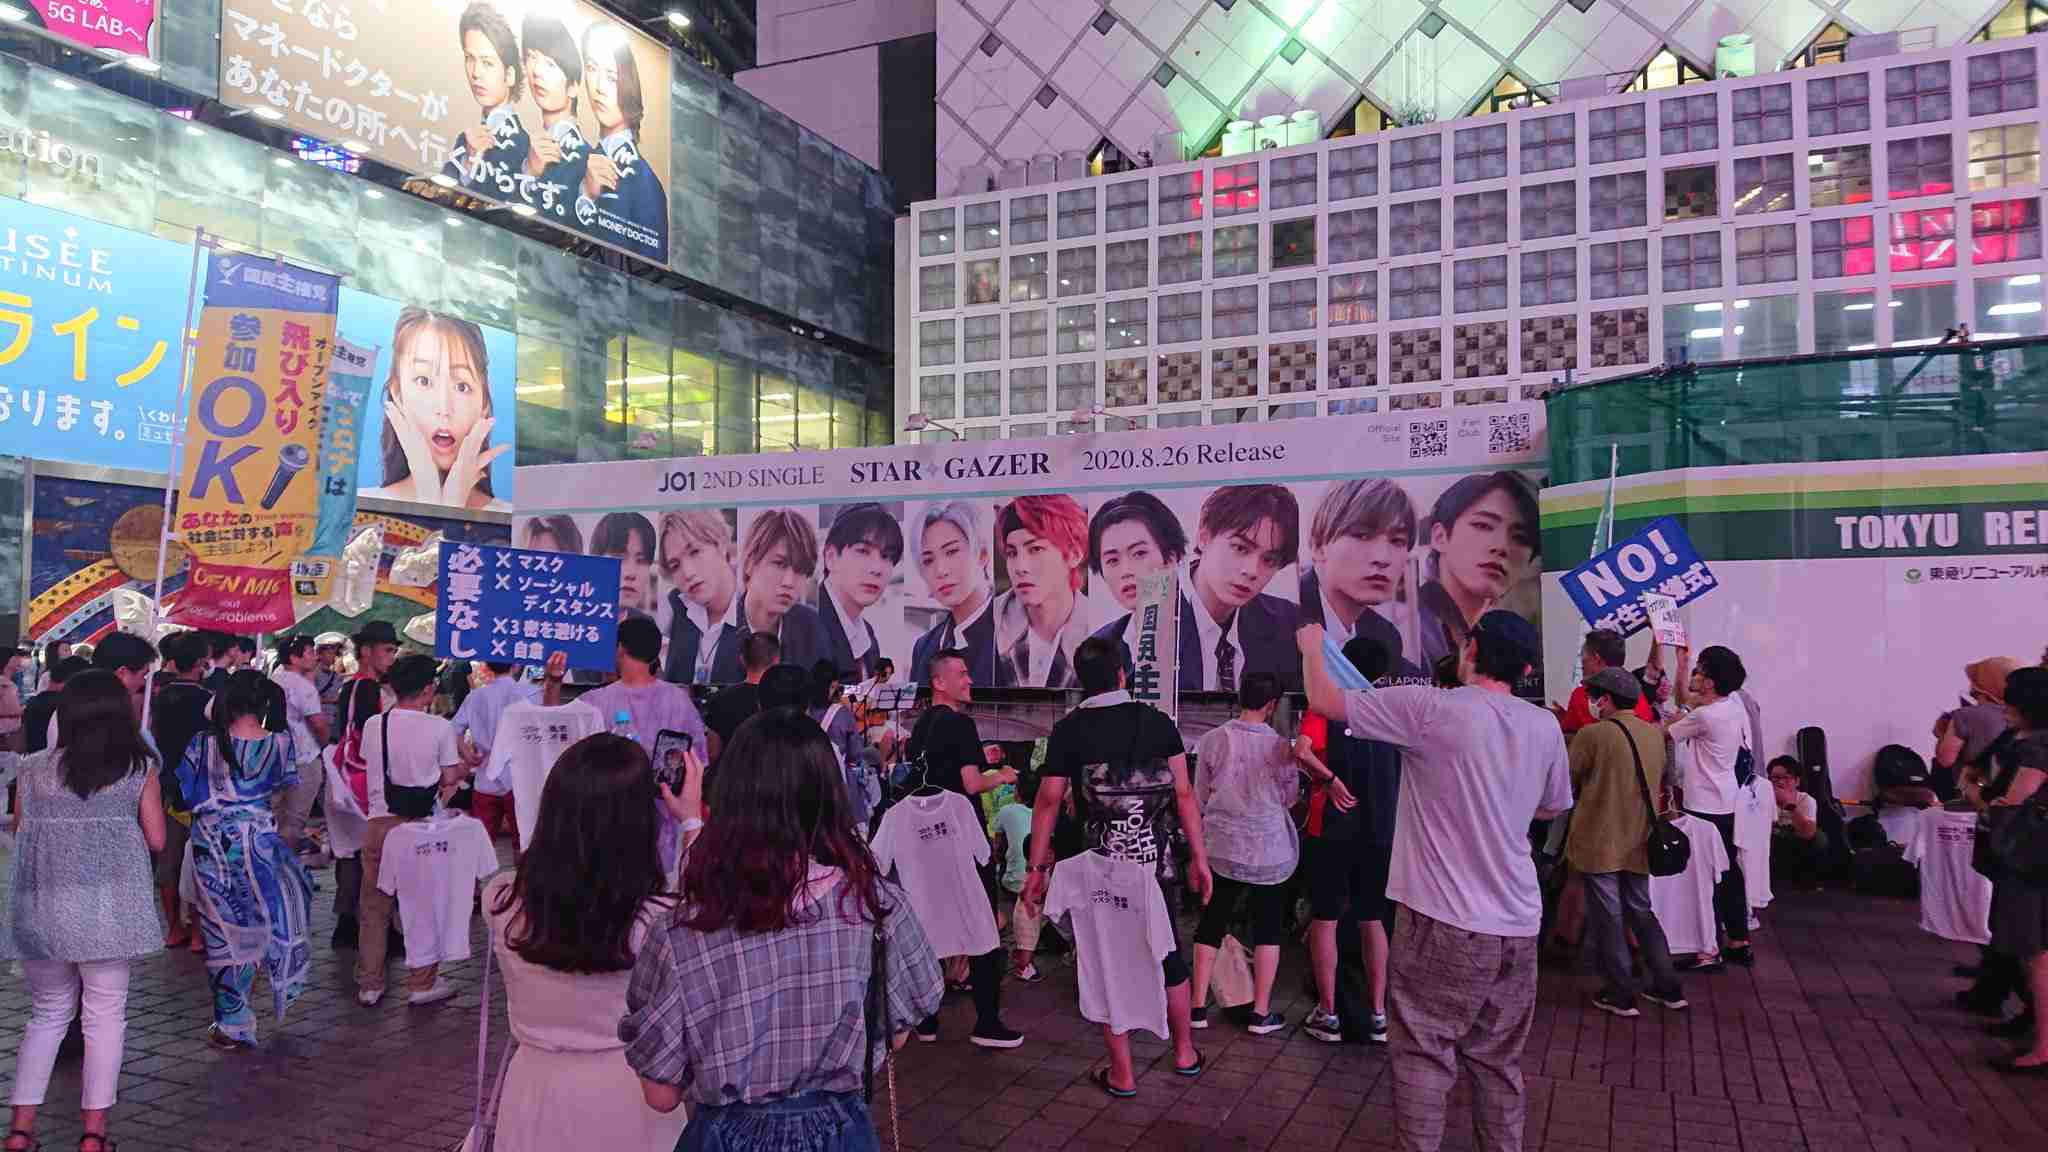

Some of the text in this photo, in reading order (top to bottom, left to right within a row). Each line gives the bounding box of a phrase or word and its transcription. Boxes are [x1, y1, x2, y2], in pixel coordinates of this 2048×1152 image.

[47, 1, 76, 24] 5G
[227, 9, 449, 121] マネードクターが
[598, 217, 628, 237] MONEY
[627, 227, 660, 249] DOCTOR
[273, 320, 311, 436] 飛び入り
[658, 441, 1286, 493] JO1 2ND SINGLE STAR GAZER 2020.8.26 Release
[1835, 512, 1960, 550] TOKYU
[518, 575, 596, 600] ソーシャル
[1576, 528, 1679, 608] NO!
[446, 543, 484, 659] 必要なし
[522, 593, 615, 619] ディスタンス
[1594, 561, 1714, 636] 新生様式
[1140, 823, 1158, 862] THE
